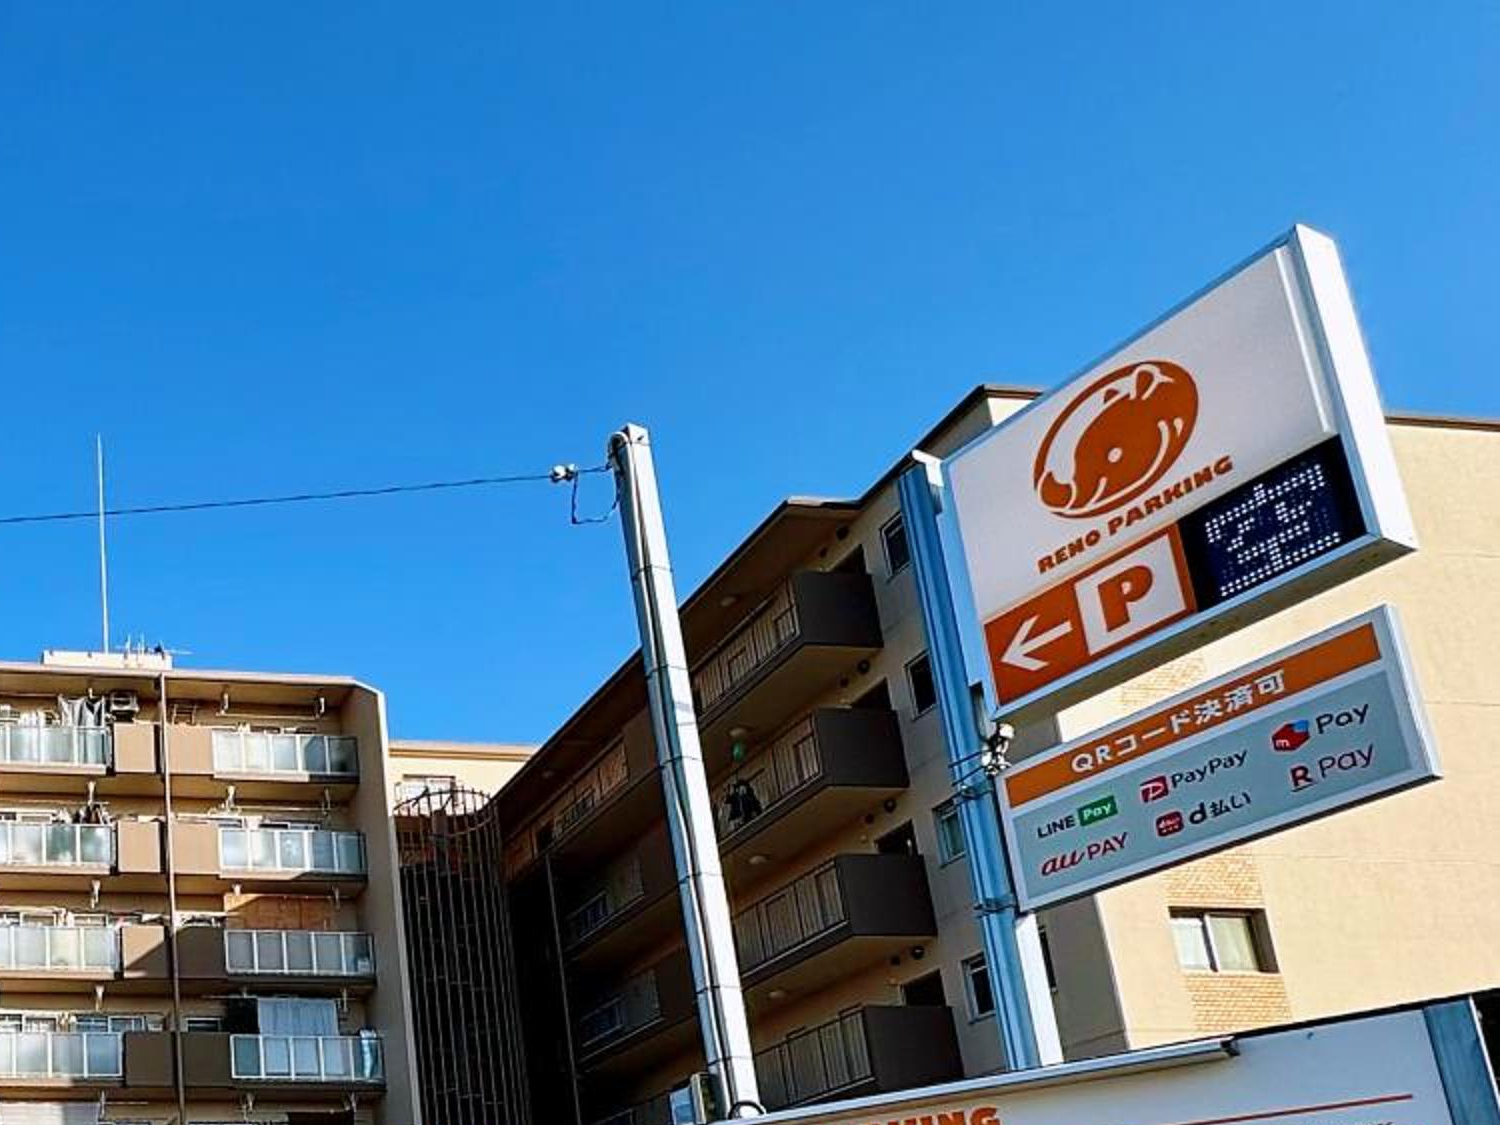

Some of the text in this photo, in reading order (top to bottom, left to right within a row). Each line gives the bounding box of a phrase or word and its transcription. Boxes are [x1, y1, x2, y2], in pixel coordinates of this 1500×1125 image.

[1038, 455, 1234, 574] RENO PARKING
[1205, 463, 1341, 597] 空
[1098, 565, 1154, 633] P
[1071, 670, 1285, 774] QRコード決済可
[1315, 703, 1370, 735] Pay
[1171, 750, 1248, 789] PayPay
[1291, 744, 1374, 788] R Pay
[1037, 803, 1112, 839] LINE Pay
[1189, 792, 1252, 825] d払い
[1086, 832, 1128, 860] PAY
